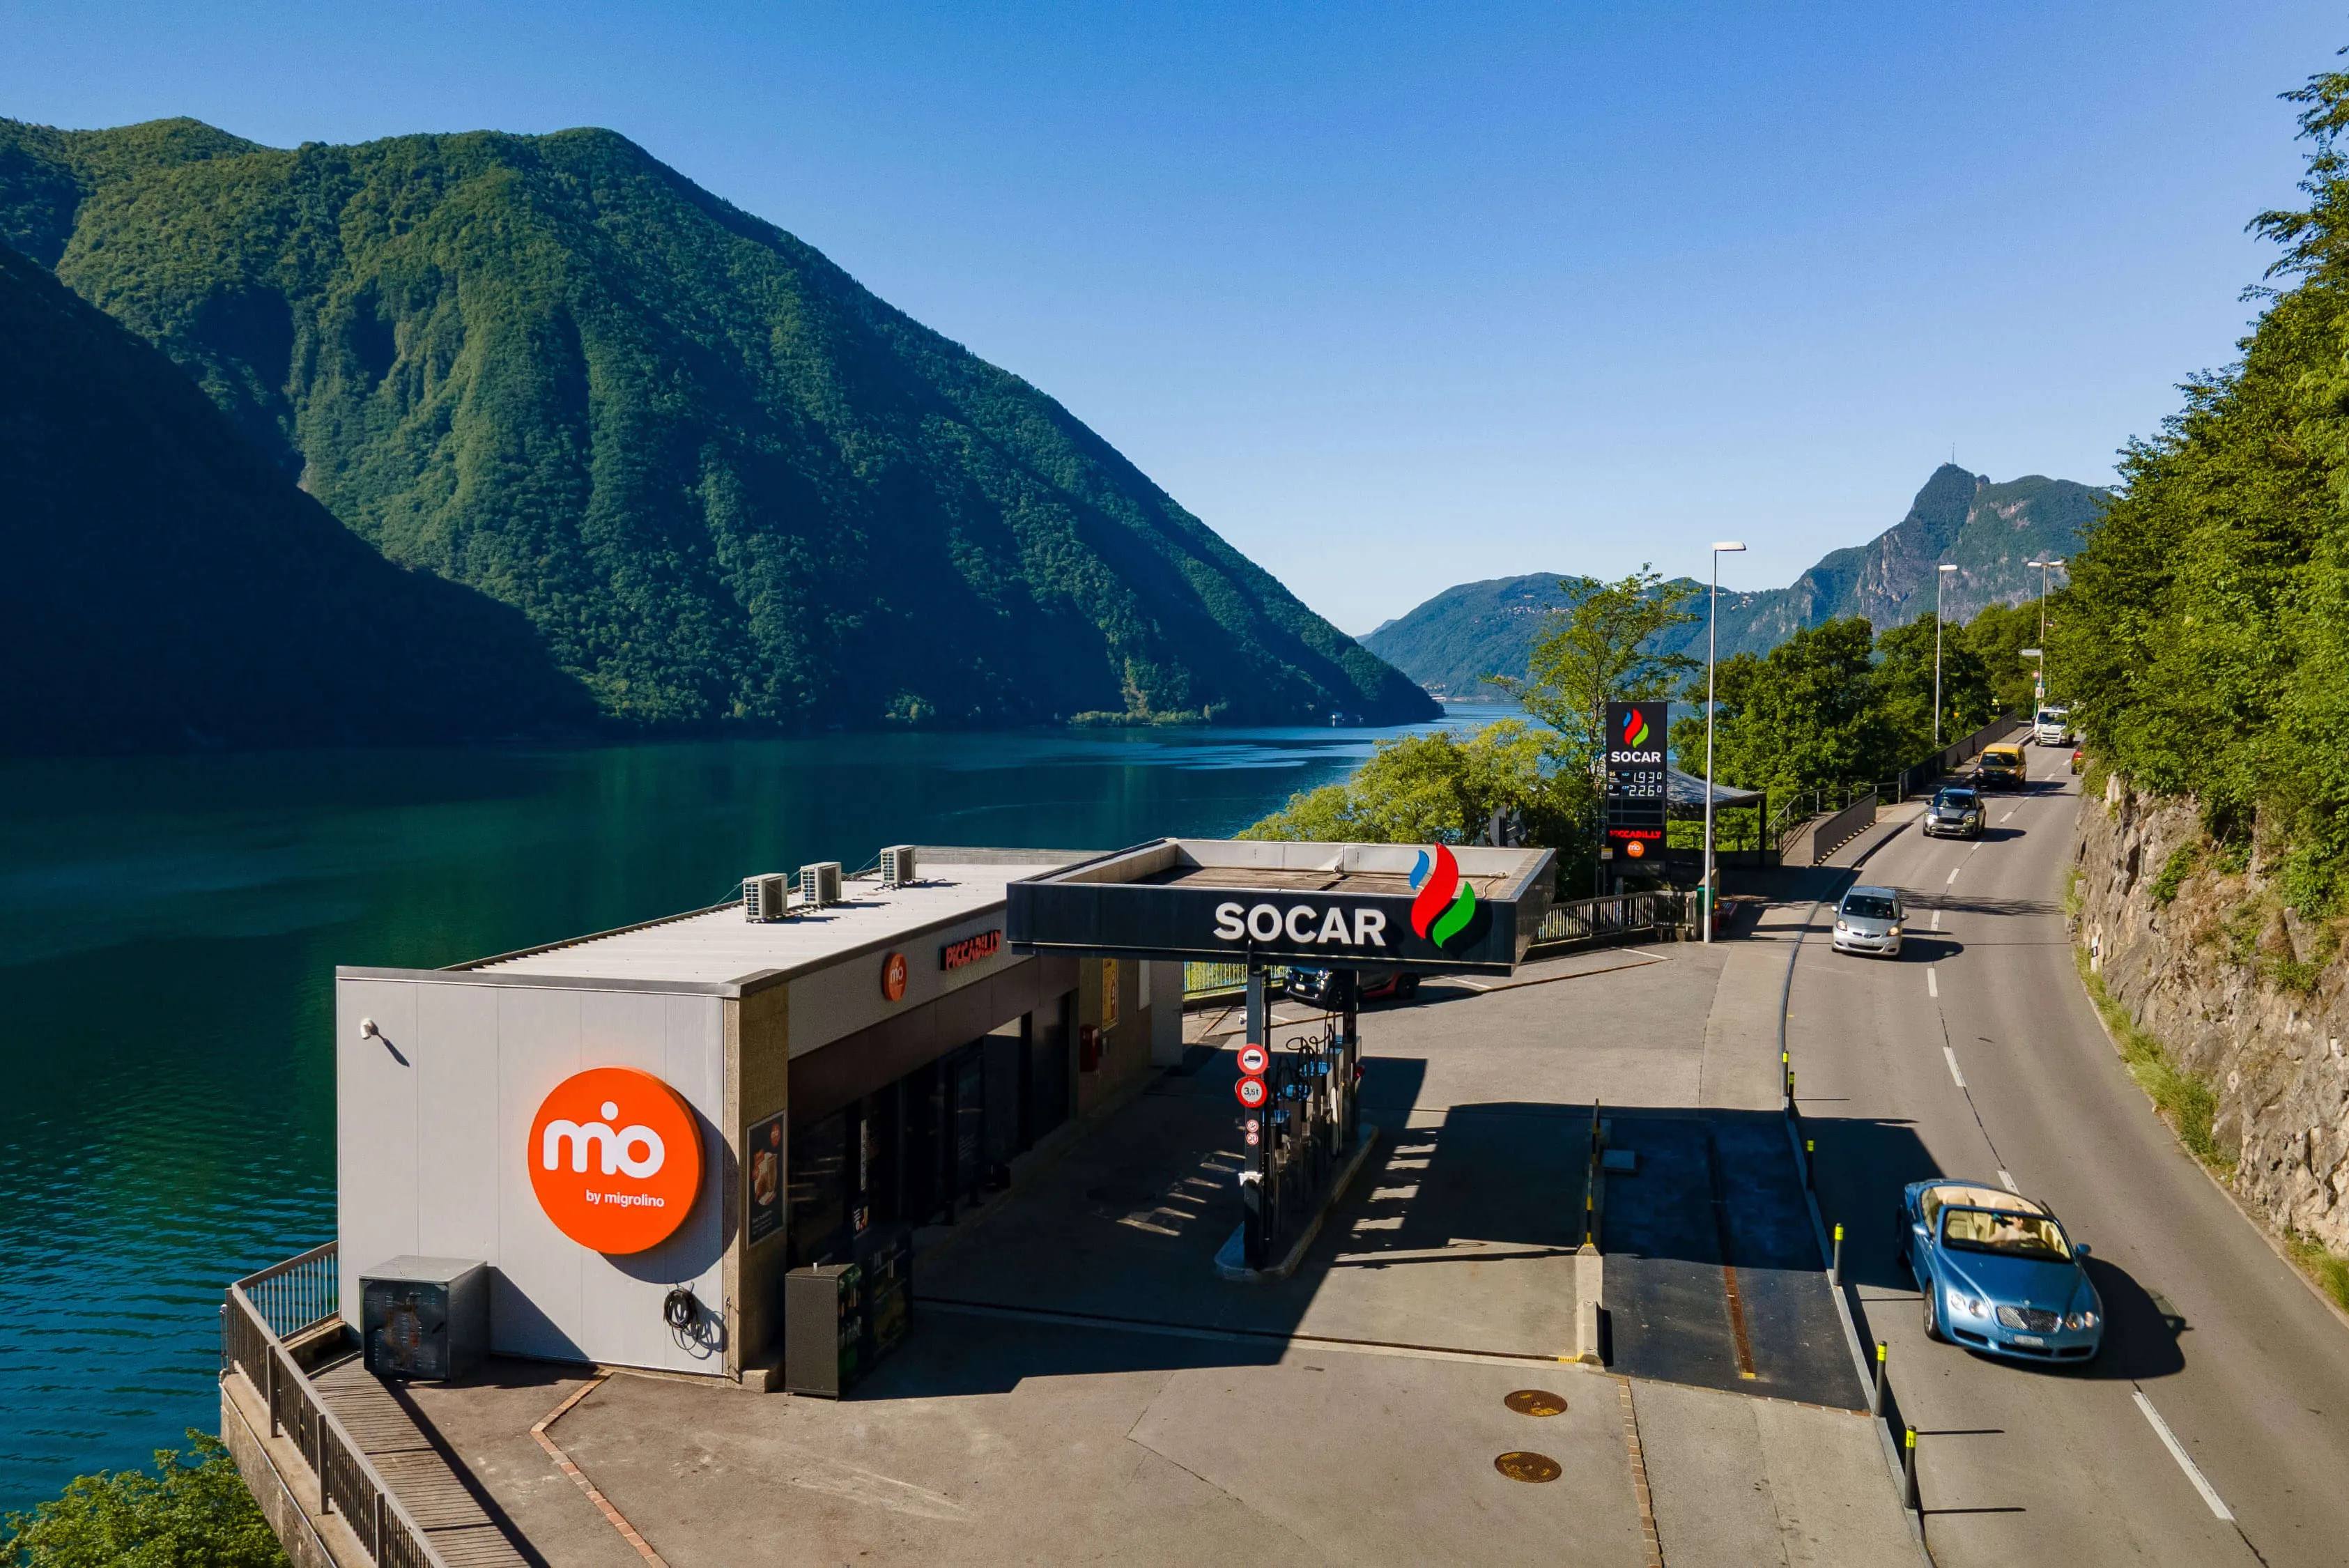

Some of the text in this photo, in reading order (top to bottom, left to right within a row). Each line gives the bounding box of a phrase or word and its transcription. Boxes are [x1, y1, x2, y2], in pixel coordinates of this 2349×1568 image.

[1610, 751, 1661, 763] SOCAR
[1609, 830, 1662, 839] PICCADILLY
[1212, 902, 1387, 946] SOCAR
[946, 930, 1002, 971] PICCADILLY
[890, 961, 904, 983] mio
[543, 1101, 665, 1178] mio
[585, 1189, 665, 1208] by migrolino
